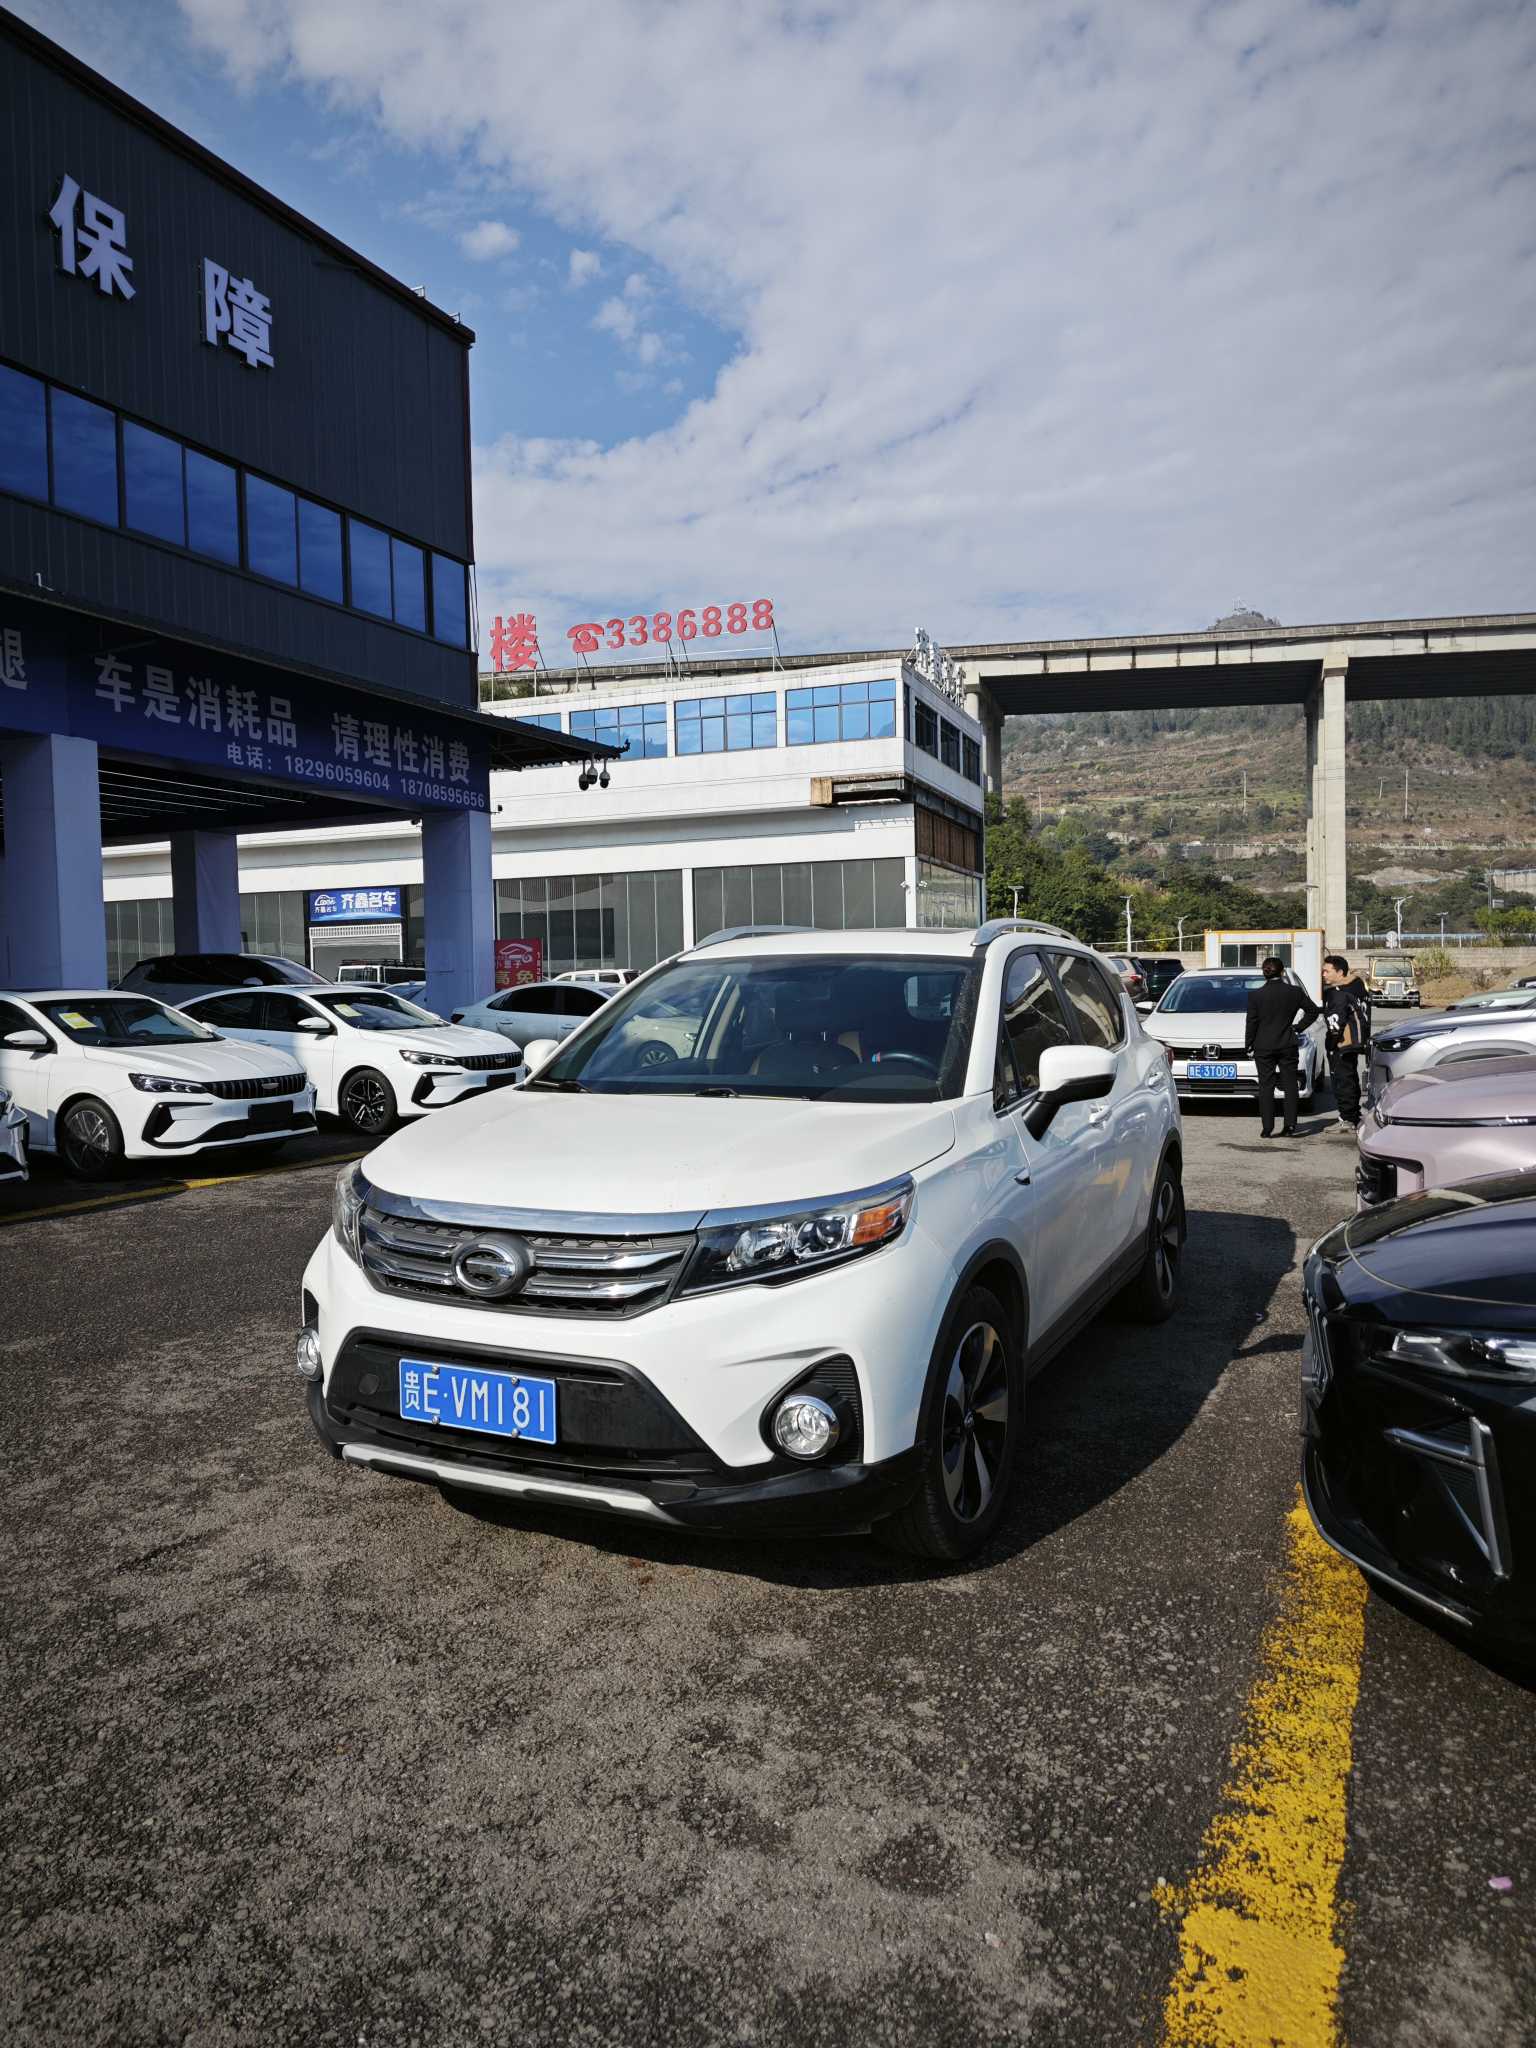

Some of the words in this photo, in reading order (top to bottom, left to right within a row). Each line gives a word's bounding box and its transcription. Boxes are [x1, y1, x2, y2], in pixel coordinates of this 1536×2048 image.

[50, 173, 275, 369] 保障
[490, 613, 538, 672] 楼
[606, 598, 773, 649] 3386888
[94, 653, 298, 748] 车是消耗品
[331, 711, 470, 785] 请理性消费
[284, 754, 391, 791] 18296059604
[400, 778, 485, 808] 18708595656
